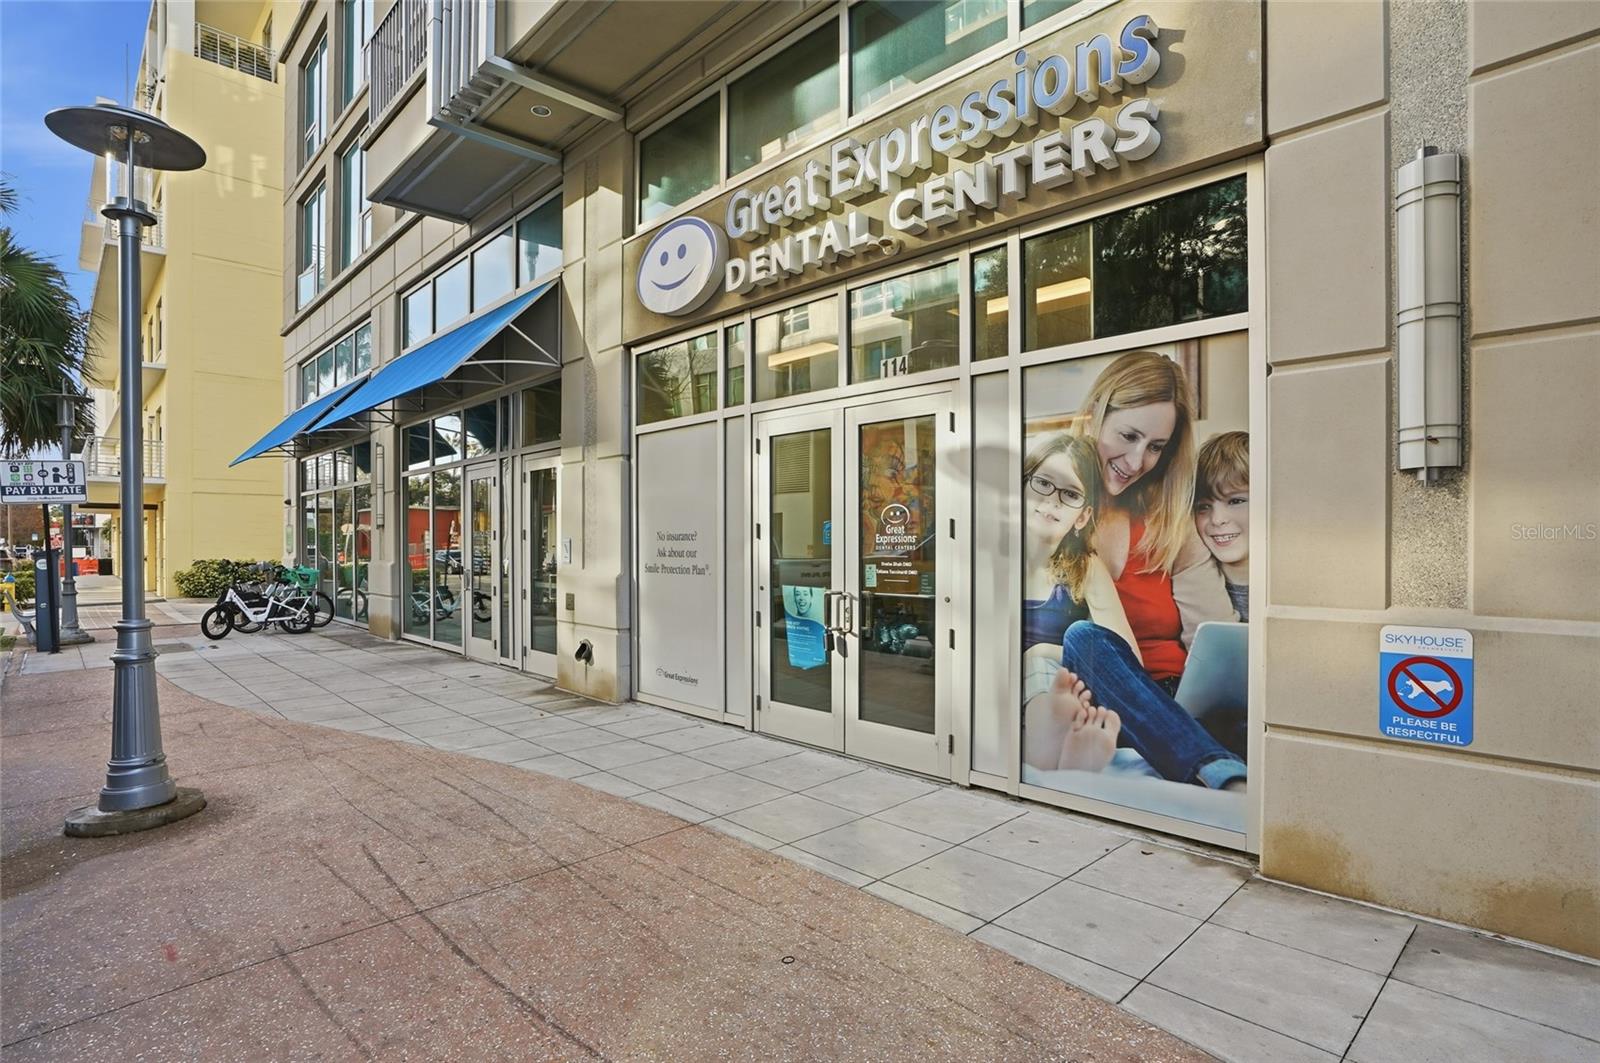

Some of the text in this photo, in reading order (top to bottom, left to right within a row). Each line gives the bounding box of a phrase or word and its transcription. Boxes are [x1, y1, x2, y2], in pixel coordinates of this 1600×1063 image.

[726, 15, 1160, 242] Great Expressions
[725, 98, 1161, 293] DENTAL CENTERS
[882, 356, 907, 378] 114
[5, 486, 82, 495] PAY BY PLATE
[885, 524, 905, 534] Great
[656, 531, 697, 541] No insurance?
[657, 547, 698, 558] Ask about our
[645, 563, 660, 574] Smile
[661, 564, 691, 575] Protection
[1385, 633, 1464, 649] SKYHOUSE
[664, 671, 675, 680] Great
[1392, 716, 1457, 731] PLEASE BE
[1386, 726, 1464, 744] RESPECTFUL
